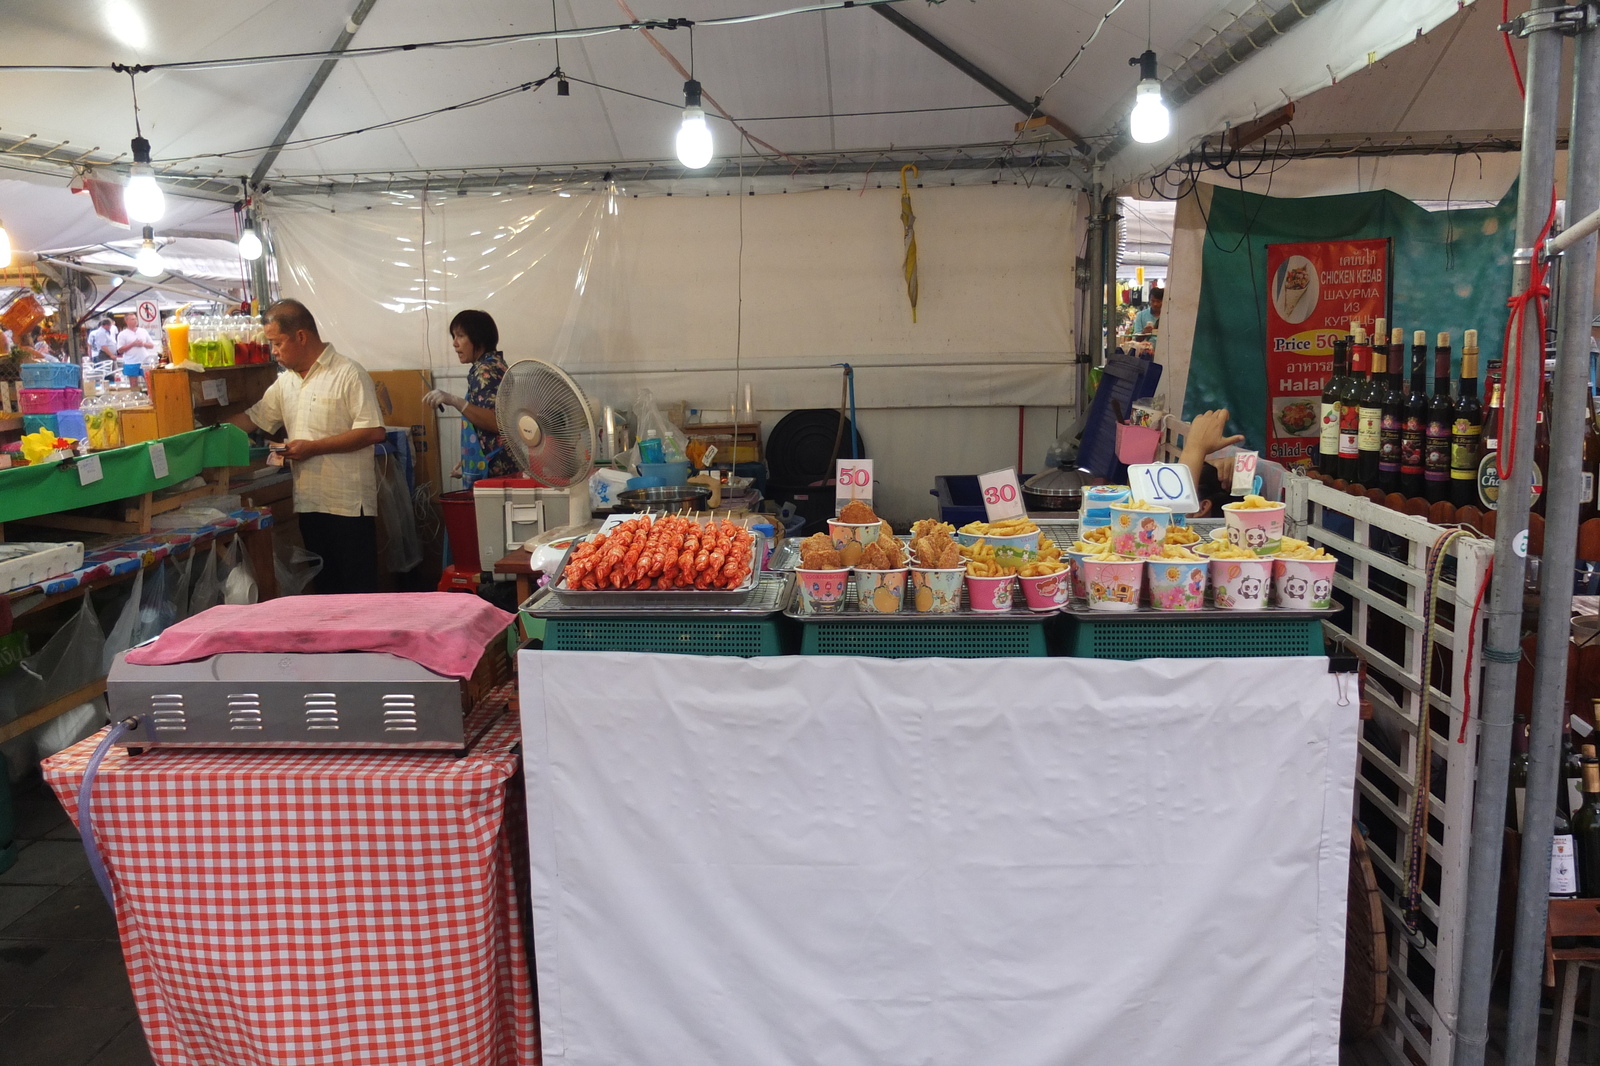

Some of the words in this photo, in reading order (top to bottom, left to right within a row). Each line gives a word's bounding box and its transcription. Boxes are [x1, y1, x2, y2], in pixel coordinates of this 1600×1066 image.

[1320, 270, 1355, 285] CHICKEN
[1357, 268, 1382, 283] KEBAB
[1323, 288, 1380, 301] ШАУРМА
[1343, 302, 1360, 313] ИЗ
[1273, 337, 1311, 352] Price
[1316, 333, 1338, 349] 50
[1286, 360, 1334, 373] อาหารฮ
[1279, 377, 1324, 392] Halal
[1235, 454, 1257, 473] 50
[839, 467, 870, 487] 50
[1144, 466, 1184, 500] 10
[984, 484, 1017, 505] 30
